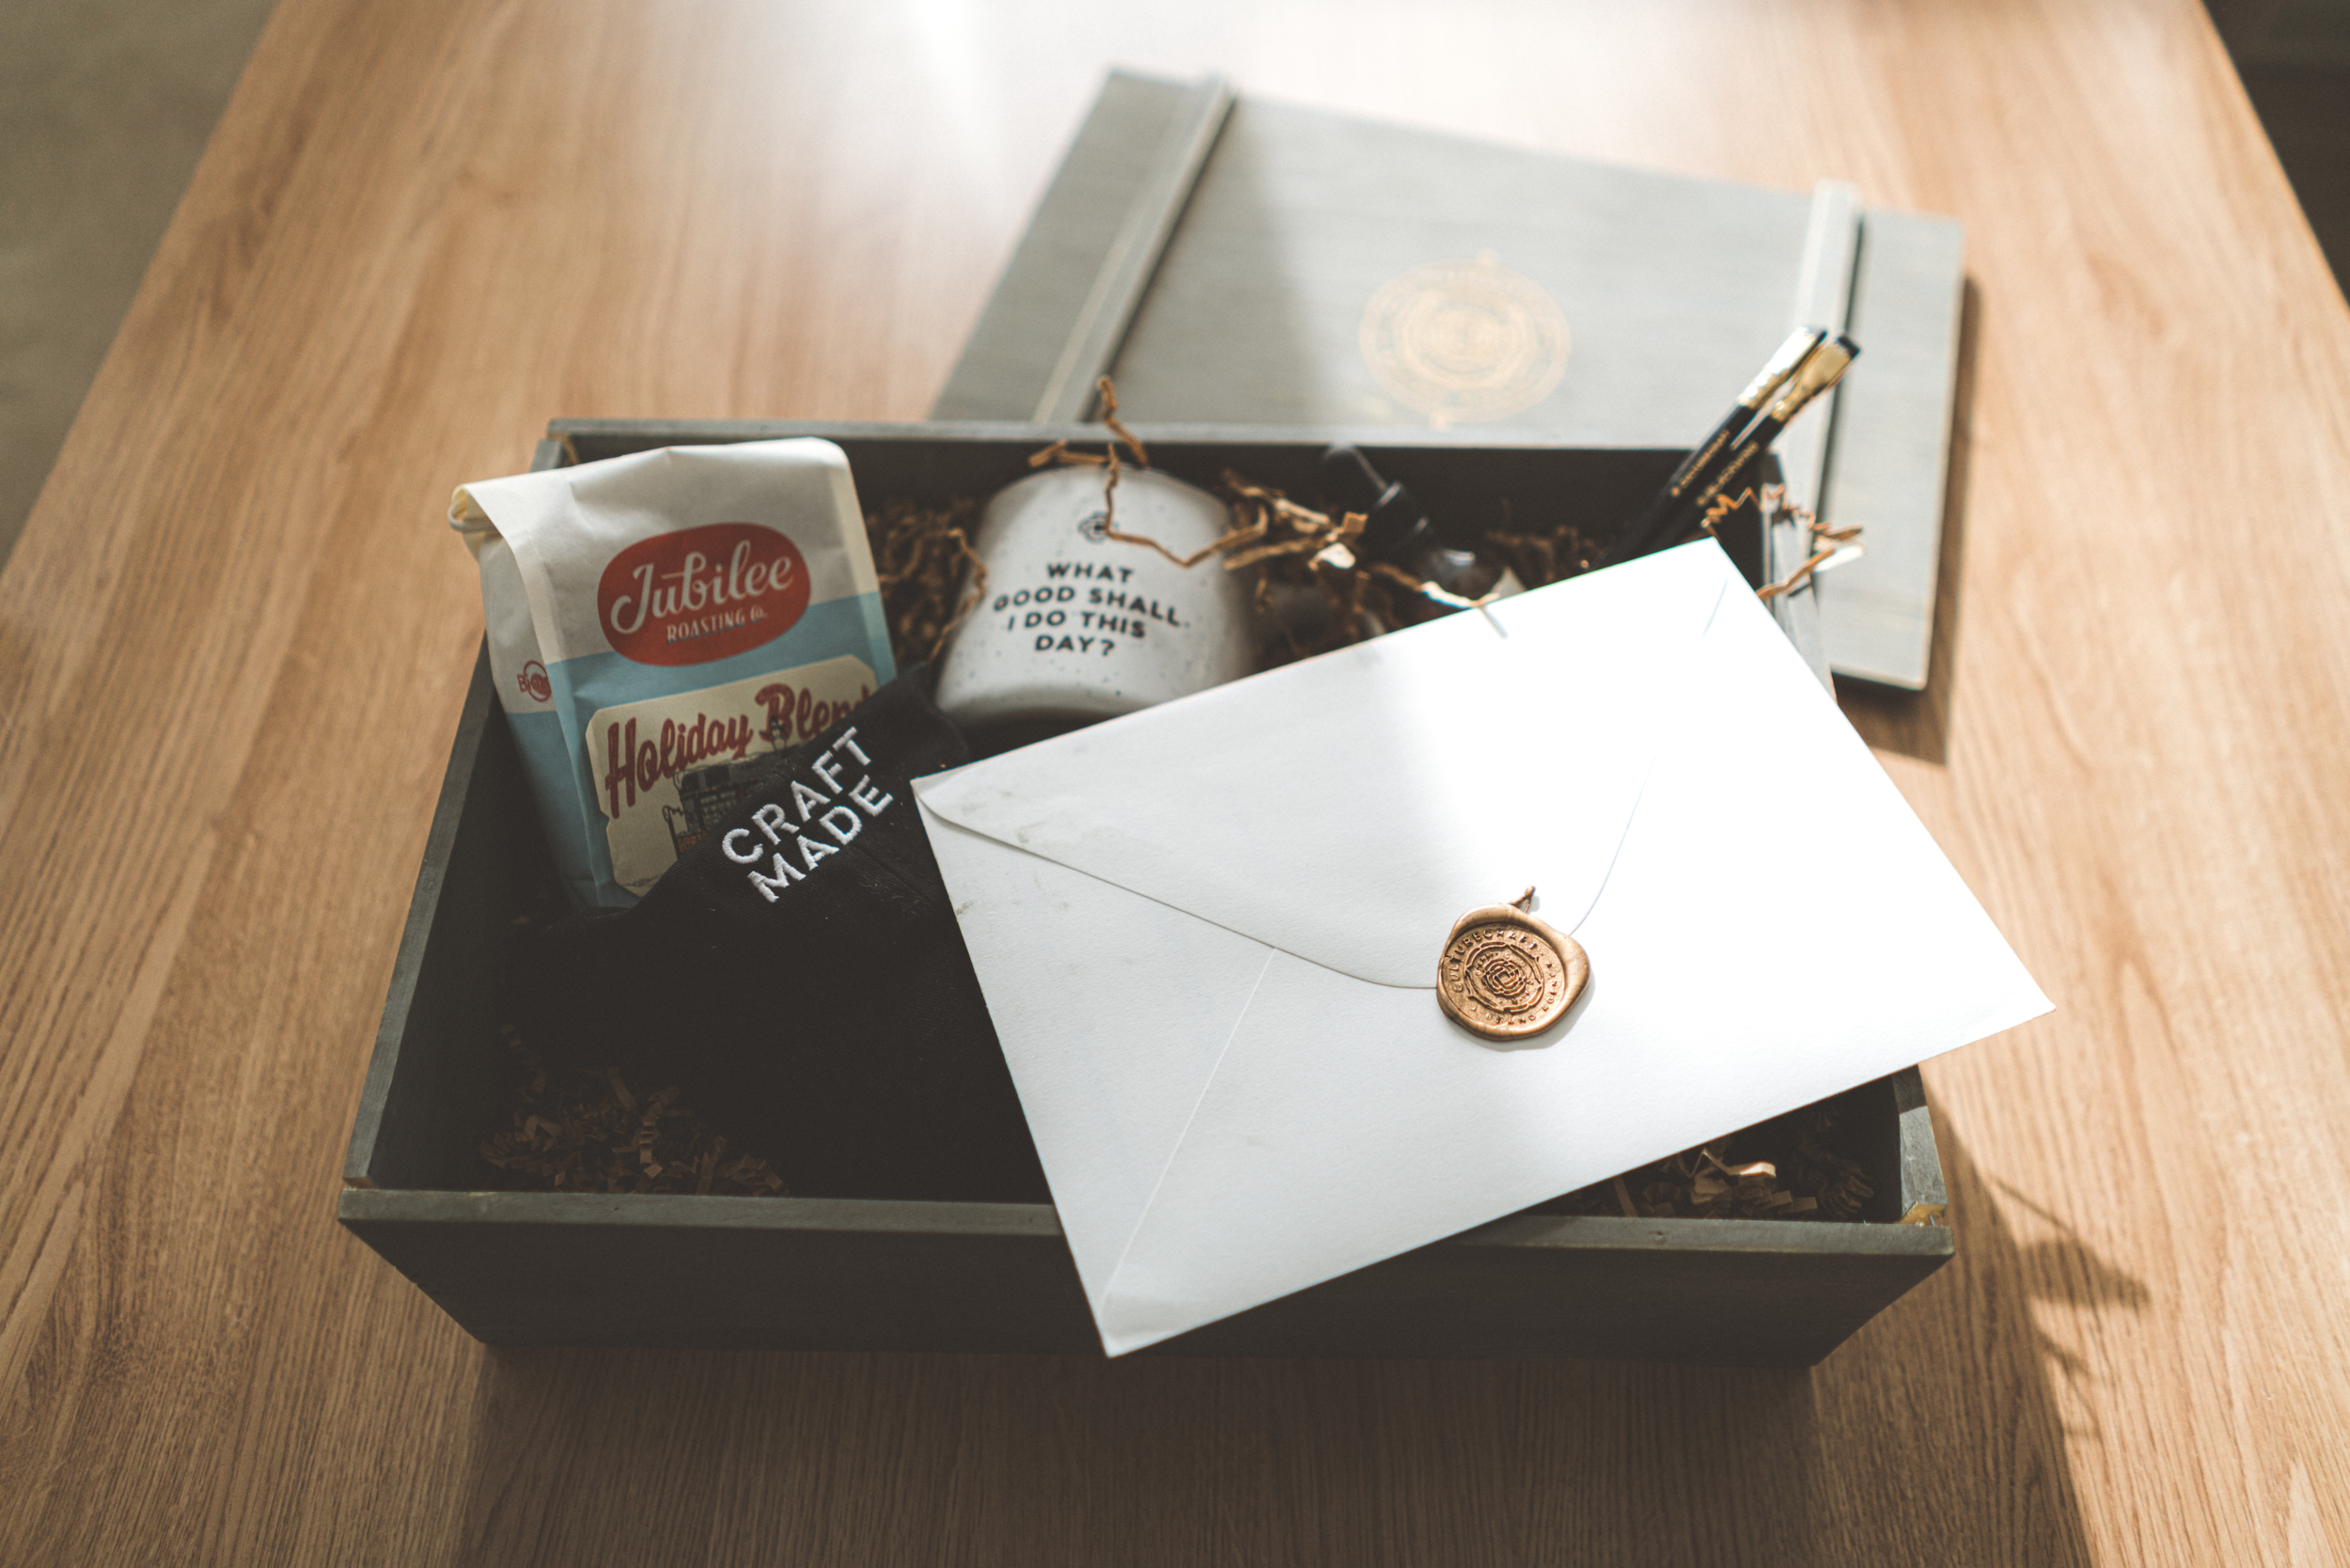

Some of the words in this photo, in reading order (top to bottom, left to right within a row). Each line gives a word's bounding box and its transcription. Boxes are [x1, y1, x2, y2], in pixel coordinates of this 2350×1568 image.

[609, 540, 793, 635] Jubilee
[1047, 562, 1134, 584] WHAT
[666, 607, 746, 645] ROASTING
[993, 586, 1075, 612] GOOD
[1089, 588, 1182, 628] SHALL
[1007, 615, 1016, 632] I
[1024, 609, 1067, 629] DO
[1082, 611, 1147, 639] THIS
[1035, 635, 1115, 656] DAY?
[605, 713, 753, 819] Holiday
[755, 682, 871, 744] Blen
[722, 726, 871, 864] CRAFT
[747, 774, 893, 902] MADE
